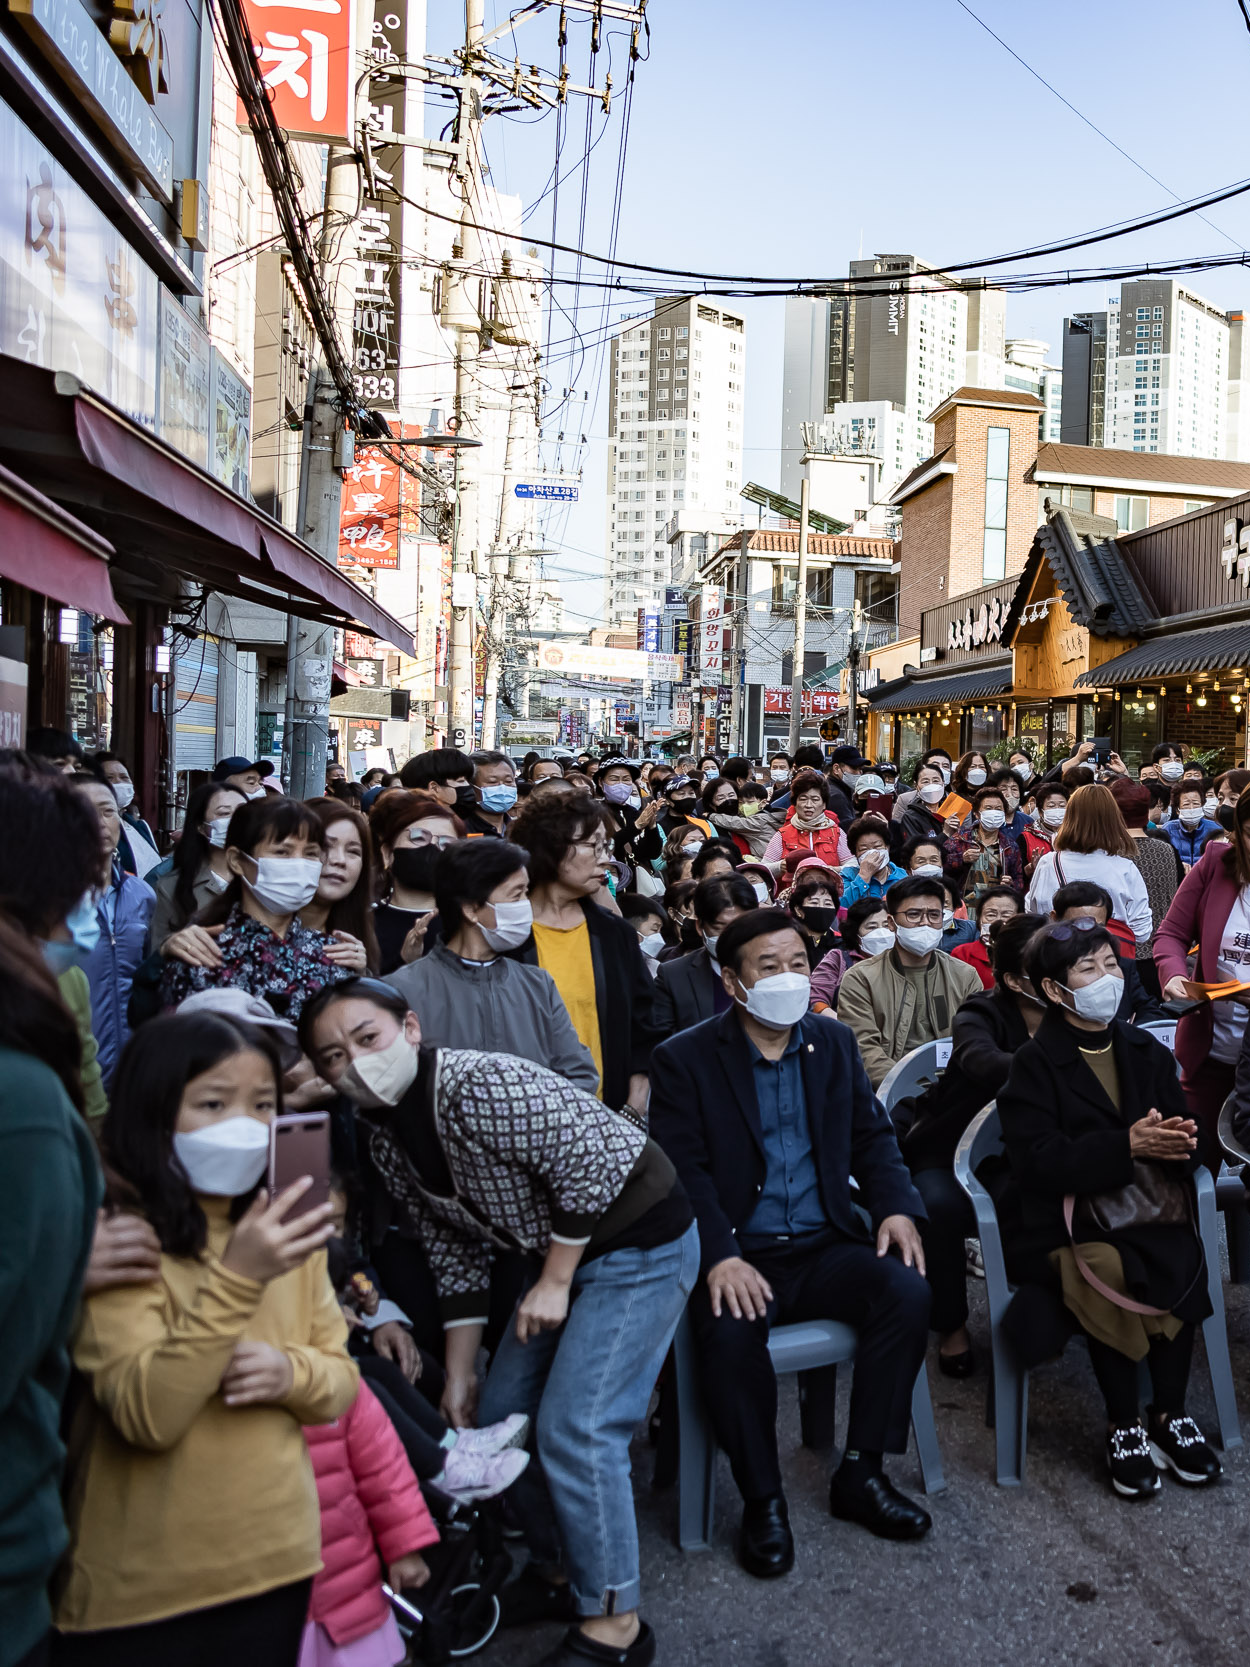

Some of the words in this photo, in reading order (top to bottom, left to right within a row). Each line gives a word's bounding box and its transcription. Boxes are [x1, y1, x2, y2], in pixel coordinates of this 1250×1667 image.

[96, 38, 143, 147] Whale
[528, 485, 578, 497] 아차산로28길
[867, 775, 875, 785] H
